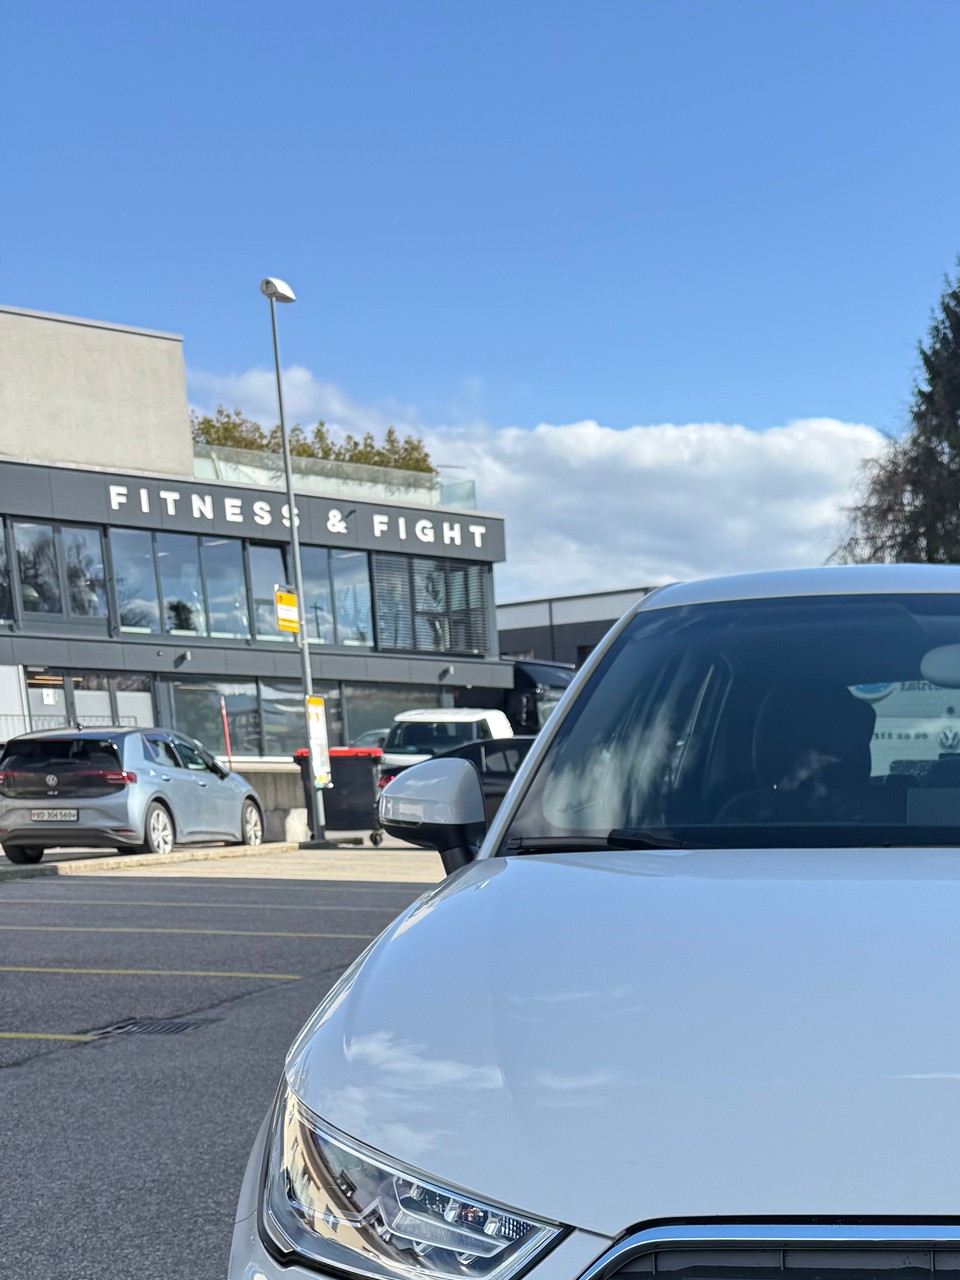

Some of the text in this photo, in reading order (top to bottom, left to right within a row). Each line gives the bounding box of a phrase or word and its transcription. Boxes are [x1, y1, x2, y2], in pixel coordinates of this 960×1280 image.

[109, 485, 486, 547] FITNESS & FIGHT
